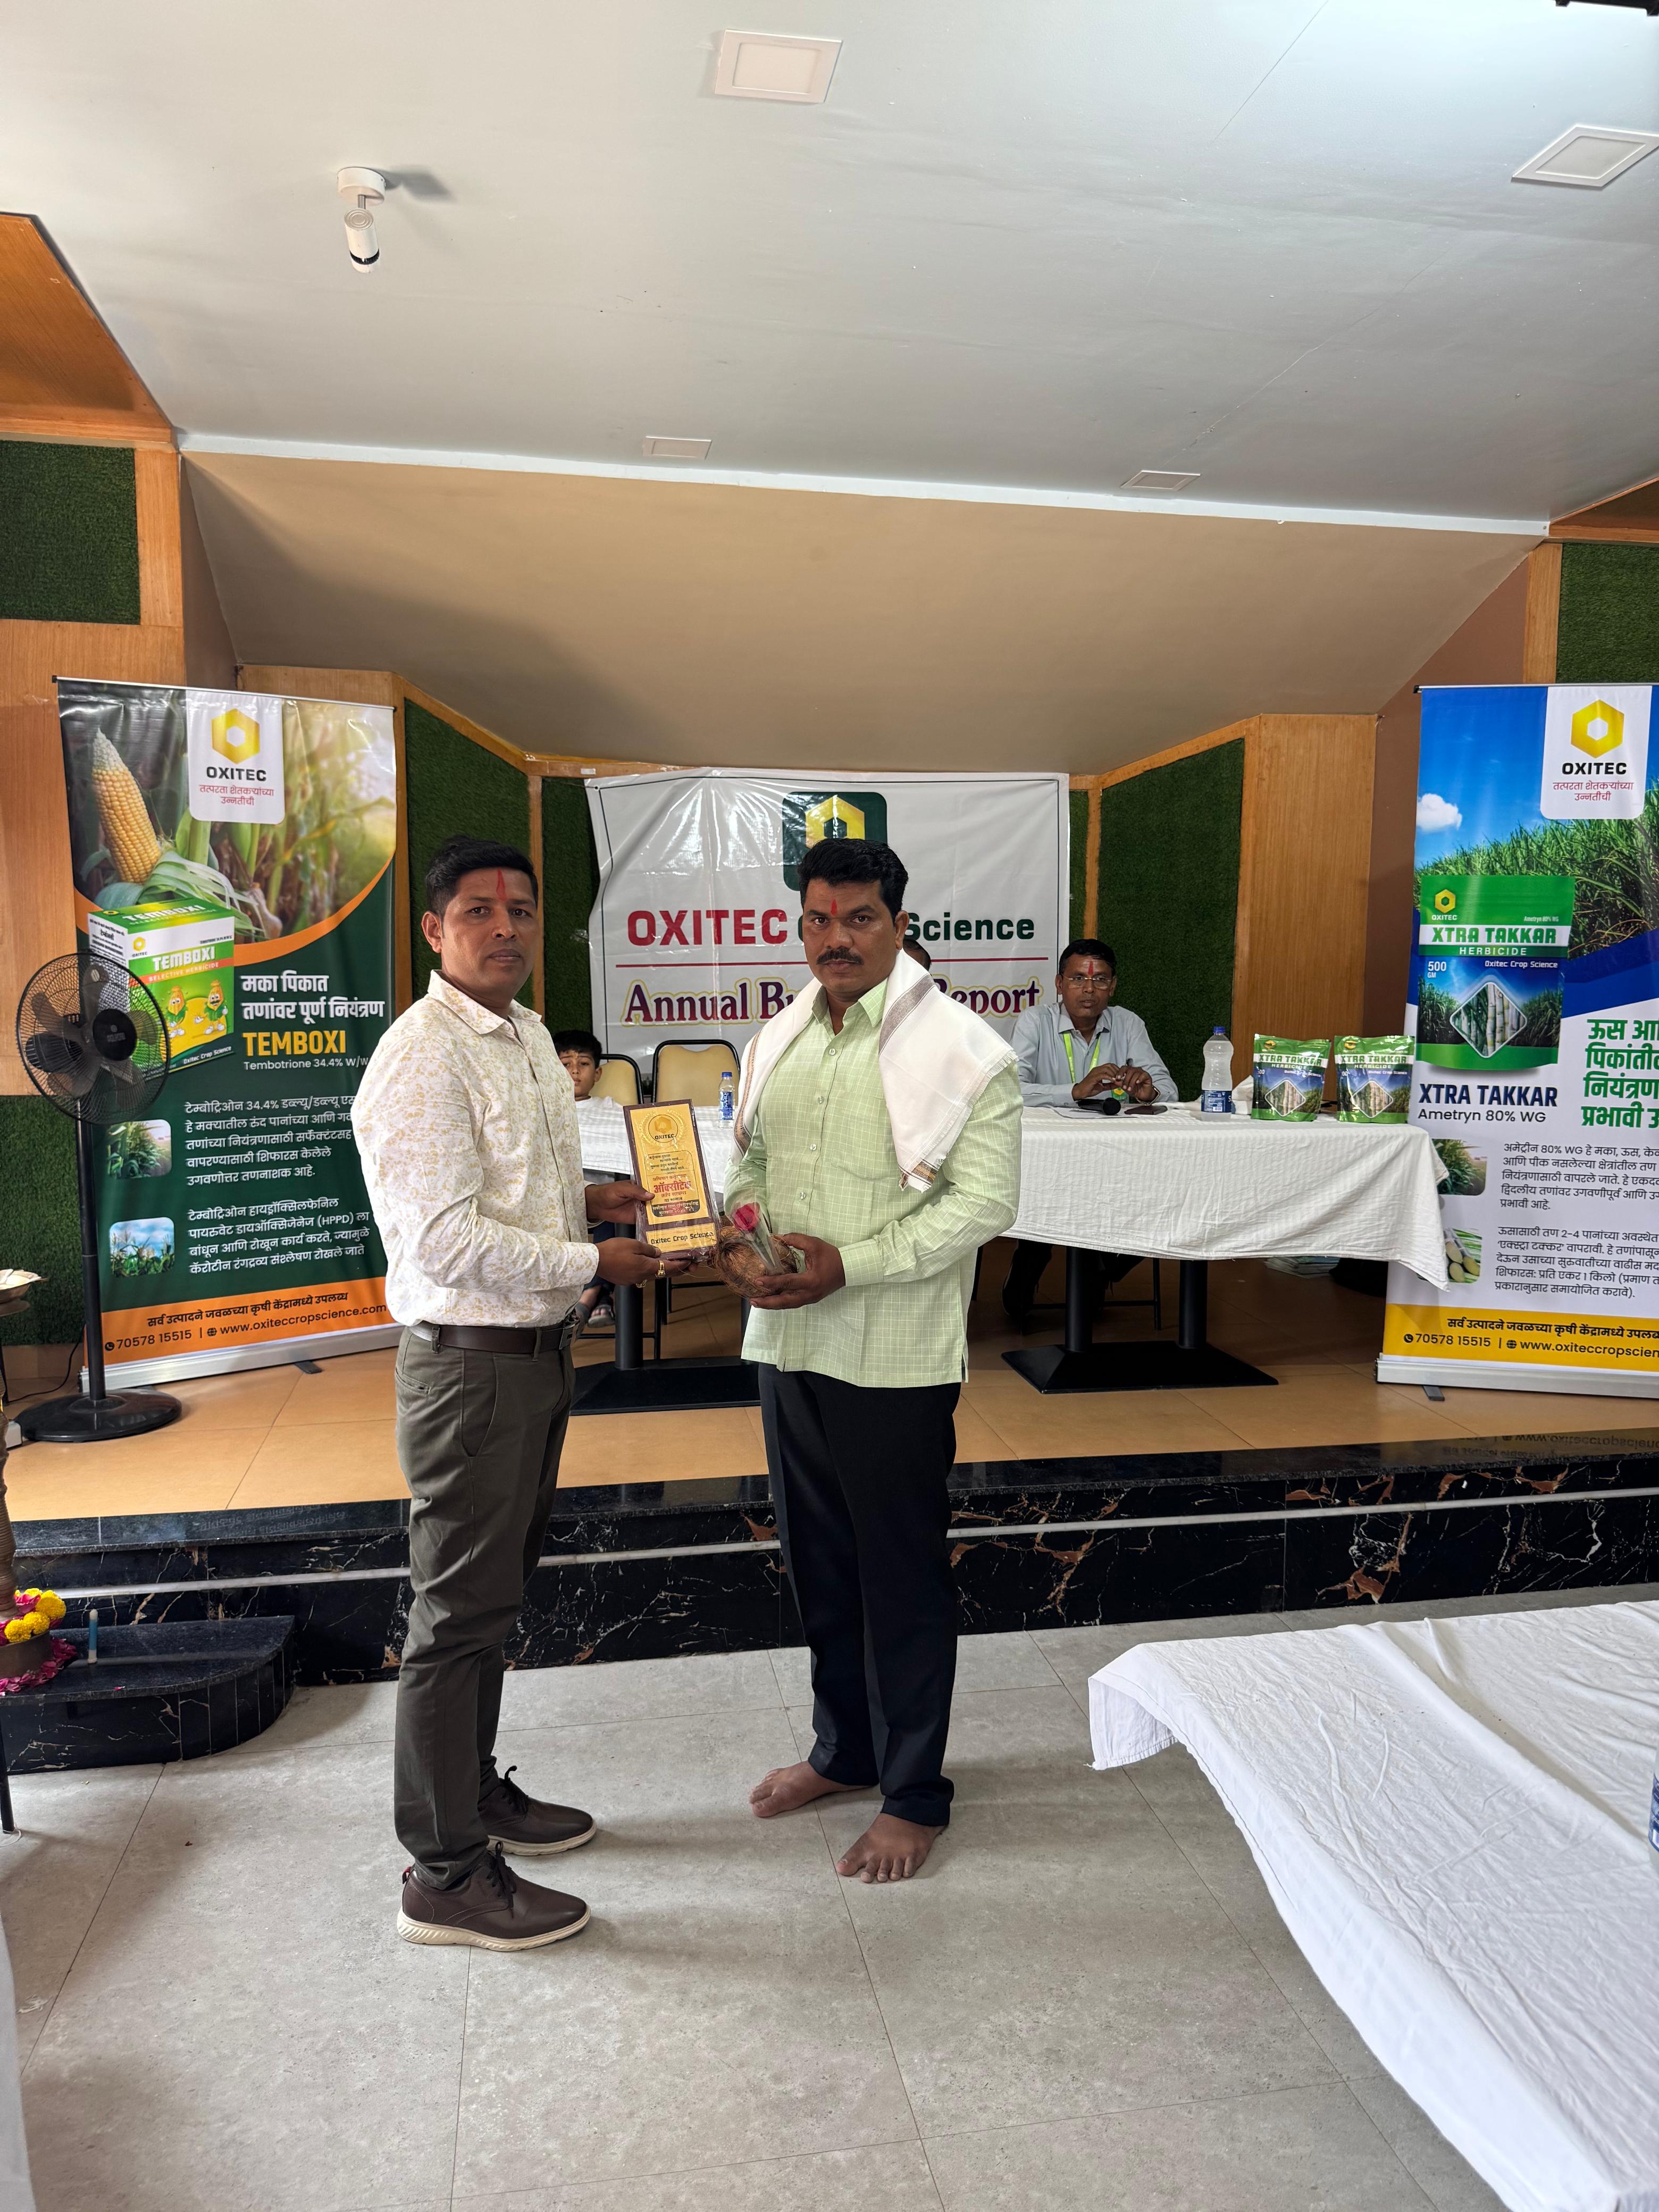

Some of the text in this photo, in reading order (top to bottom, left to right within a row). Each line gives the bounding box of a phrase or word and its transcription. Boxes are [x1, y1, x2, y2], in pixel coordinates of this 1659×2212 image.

[207, 767, 266, 781] OXITEC
[1562, 763, 1627, 775] OXITEC
[199, 785, 228, 793] तत्परता
[1574, 791, 1611, 801] उन्नतीची
[221, 796, 254, 806] उन्नतीची
[122, 904, 206, 921] TEMBOXI
[627, 909, 787, 946] OXITEC
[904, 912, 1034, 941] Science
[1432, 927, 1556, 944] XTRA TAKKAR
[153, 946, 215, 971] TEMBOXI
[1460, 947, 1527, 956] HERBICIDE
[148, 962, 219, 982] SELECTIVE HERBICIDE
[1428, 961, 1446, 971] 500
[240, 970, 329, 993] मका पिकात
[241, 996, 386, 1025] तणांवर पूर्ण नियंत्रण
[624, 982, 749, 1023] Annual
[1587, 1019, 1628, 1040] ऊस
[242, 1030, 346, 1056] TEMBOXI
[183, 1046, 231, 1065] Oxitec Crop Science
[244, 1060, 311, 1070] Tembotrione
[314, 1058, 343, 1068] 34.4%
[1418, 1084, 1558, 1107] XTRA TAKKAR
[185, 1099, 244, 1114] टेम्बोट्रिओन
[247, 1100, 279, 1111] 34.4%
[1581, 1101, 1644, 1128] प्रभावी
[185, 1120, 194, 1133] हे
[195, 1117, 248, 1132] मक्यातील
[250, 1116, 266, 1128] रुंद
[269, 1113, 309, 1126] पानांच्या
[311, 1111, 335, 1124] आणि
[1418, 1109, 1546, 1123] Ametryn 80% WG
[185, 1137, 226, 1151] तणांच्या
[228, 1131, 294, 1147] नियंत्रणासाठी
[1504, 1142, 1539, 1153] अमेट्रीन
[1541, 1145, 1562, 1154] 80%
[1585, 1144, 1592, 1155] हे
[1594, 1146, 1618, 1157] मका,
[1621, 1147, 1641, 1158] ऊस,
[186, 1146, 331, 1168] वापरण्यासाठी शिफारस केलेले
[1503, 1155, 1656, 1171] आणि पीक नसलेल्या क्षेत्रांतील तण
[187, 1164, 315, 1186] उगवणोत्तर तणनाशक आहे.
[1502, 1169, 1629, 1185] नियंत्रणासाठी वापरले जाते. हे
[1501, 1183, 1537, 1195] द्विदलीय
[1539, 1186, 1571, 1196] तणांवर
[1573, 1187, 1622, 1201] उगवणीपूर्व
[1623, 1189, 1647, 1200] आणि
[1499, 1197, 1551, 1210] प्रभावी आहे.
[187, 1205, 246, 1221] टेम्बोट्रिओन
[188, 1224, 234, 1239] पायरुवेट
[317, 1212, 354, 1228] (HPPD)
[356, 1211, 370, 1221] ला
[188, 1226, 370, 1258] बांधून आणि रोखून कार्य करते, ज्यामुळे
[1497, 1226, 1540, 1236] ऊसासाठी
[1542, 1228, 1560, 1237] तण
[1581, 1229, 1620, 1241] पानांच्या
[1622, 1231, 1658, 1243] अवस्थेत
[1566, 1243, 1604, 1254] वापरावी.
[1606, 1244, 1614, 1255] हे
[189, 1259, 231, 1275] कॅरोटीन
[233, 1256, 269, 1270] रंगद्रव्य
[314, 1246, 343, 1260] रोखले
[344, 1243, 365, 1256] जाते
[1496, 1252, 1642, 1270] देऊन उसाच्या सुरुवातीच्या वाढीस
[1495, 1266, 1536, 1278] शिफारस:
[1538, 1268, 1556, 1279] प्रति
[1558, 1271, 1581, 1280] एकर
[1589, 1271, 1616, 1283] किलो
[1619, 1272, 1652, 1285] (प्रमाण
[1494, 1281, 1636, 1298] प्रकारानुसार समायोजित करावे).
[147, 1292, 348, 1327] सर्व उत्पादने जवळच्या कृषी केंद्रामध्ये उपलब्ध
[116, 1304, 387, 1349] 70578 15515 www.oxiteccropscience.com
[1447, 1317, 1625, 1338] सर्व उत्पादने जवळच्या कृषी केंद्रामध्ये
[1415, 1333, 1454, 1345] 70578
[1457, 1336, 1491, 1347] 15515
